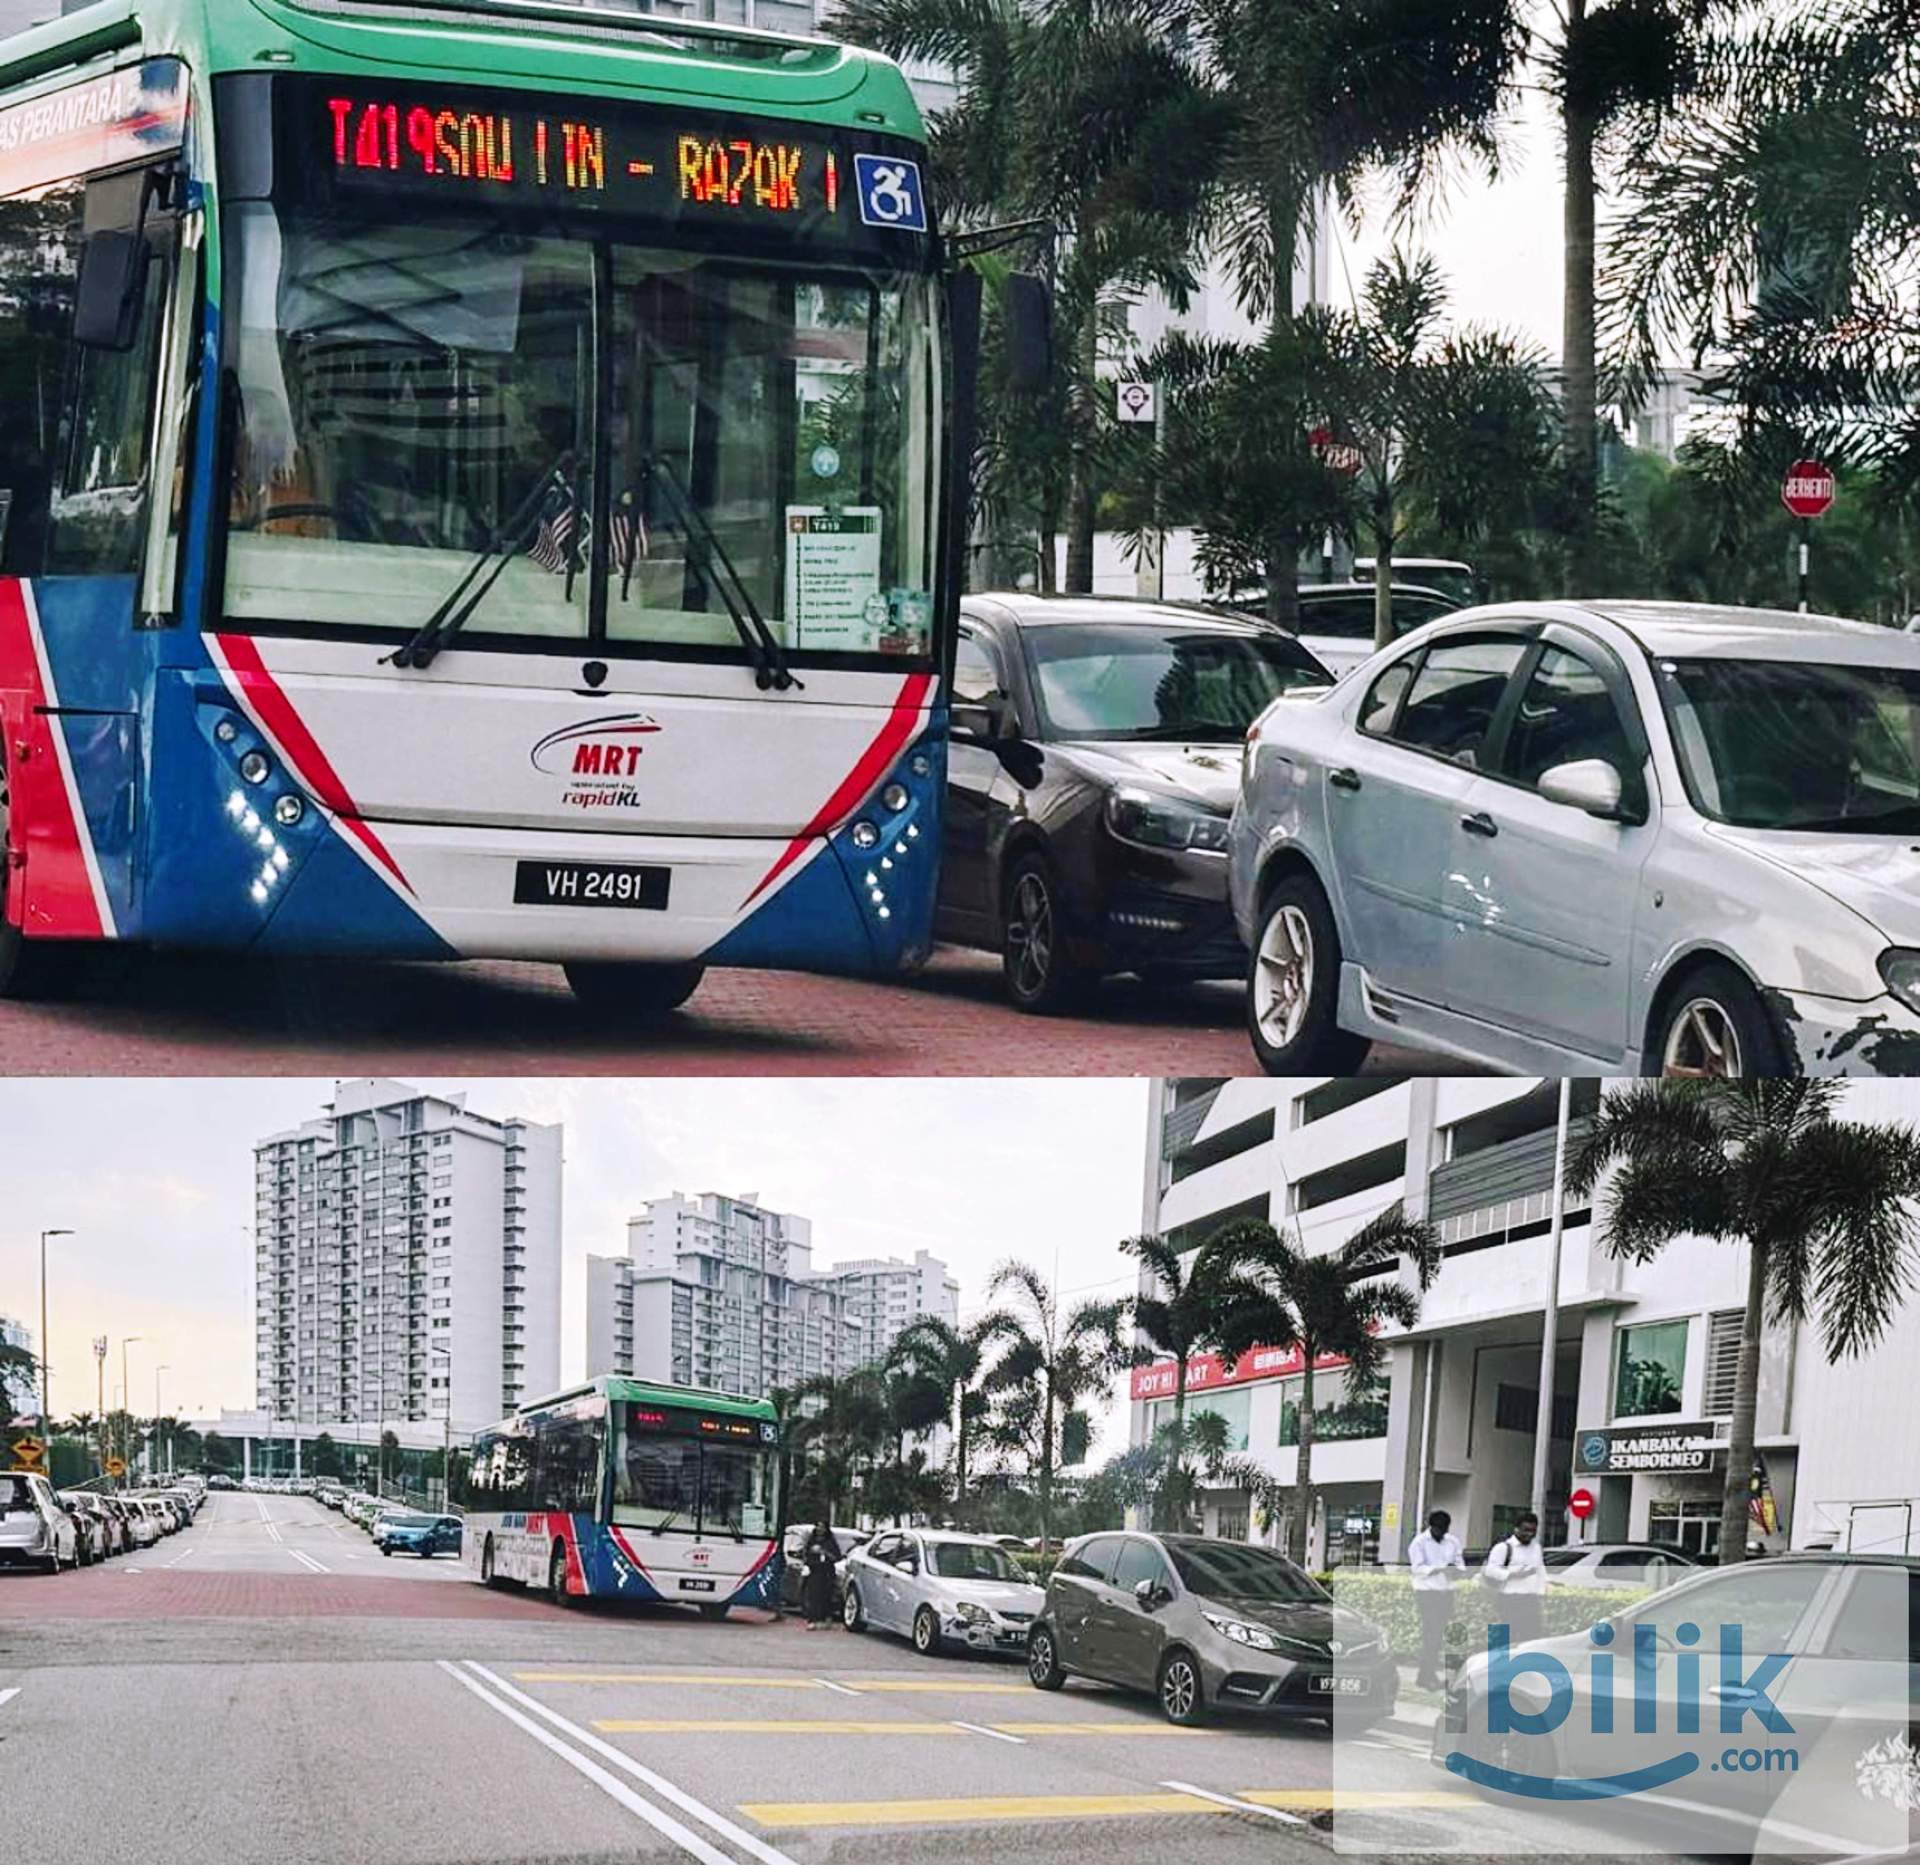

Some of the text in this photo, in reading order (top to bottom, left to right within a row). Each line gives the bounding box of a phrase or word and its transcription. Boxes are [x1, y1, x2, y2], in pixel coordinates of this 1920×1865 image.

[20, 81, 122, 146] PERANTARA
[329, 99, 436, 173] T419
[572, 743, 643, 776] MRT
[562, 790, 641, 808] rapidKL
[546, 869, 641, 900] VH 2491
[1137, 1374, 1159, 1393] JOY
[1608, 1451, 1704, 1470] SEMBORNEO
